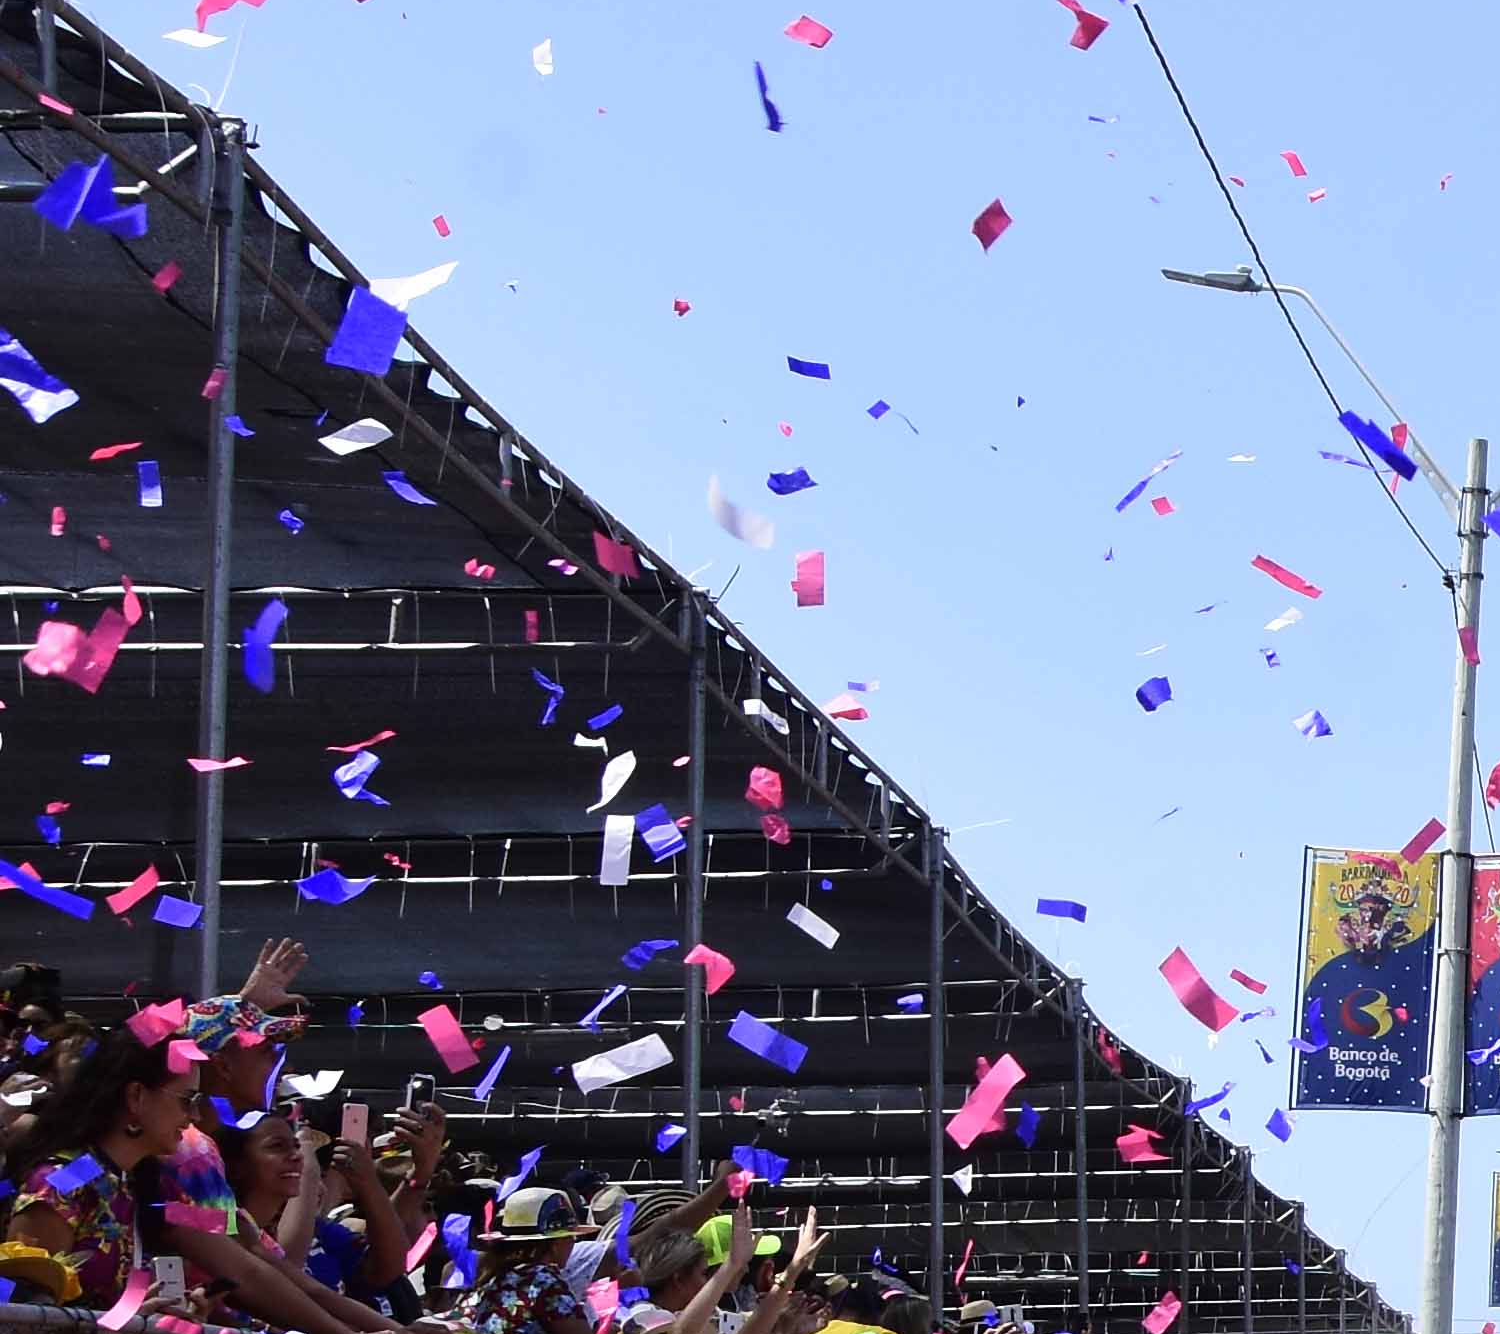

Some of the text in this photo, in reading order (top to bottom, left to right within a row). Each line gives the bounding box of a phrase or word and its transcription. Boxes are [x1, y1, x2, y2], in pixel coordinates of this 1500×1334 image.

[1339, 883, 1355, 901] 20
[1329, 1047, 1399, 1062] Banco de
[1335, 1064, 1390, 1081] Bogotá
